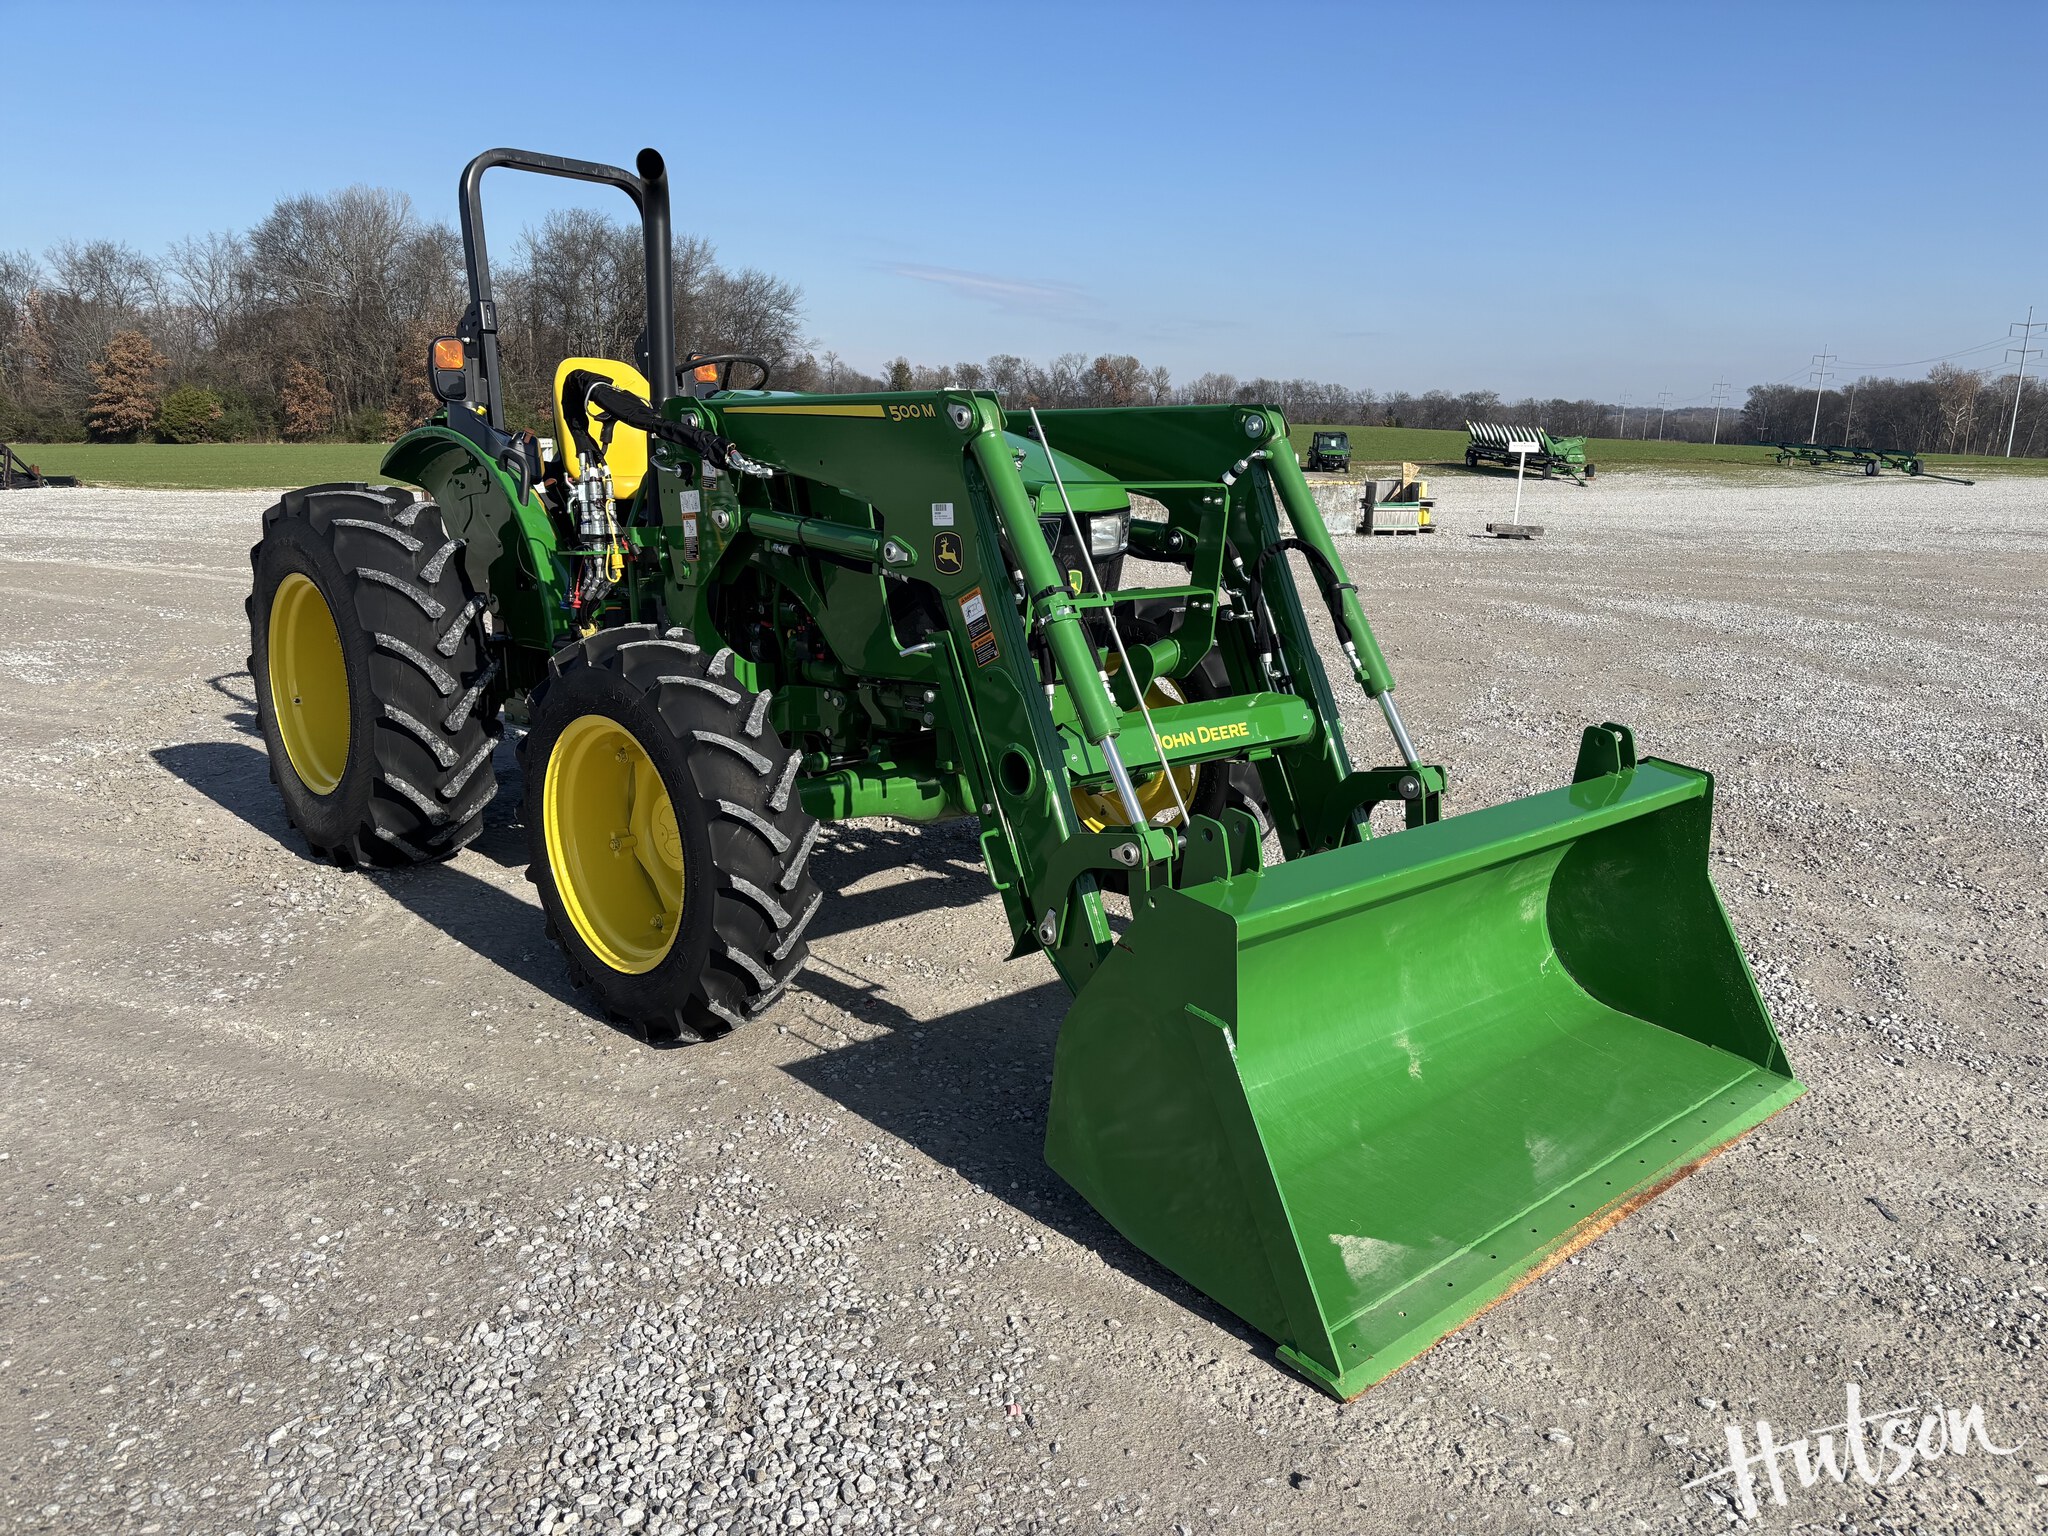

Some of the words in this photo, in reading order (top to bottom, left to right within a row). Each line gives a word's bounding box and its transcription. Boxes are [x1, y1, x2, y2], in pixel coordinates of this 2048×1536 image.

[888, 404, 921, 422] 500
[920, 403, 937, 418] M
[1197, 722, 1250, 743] DEERE
